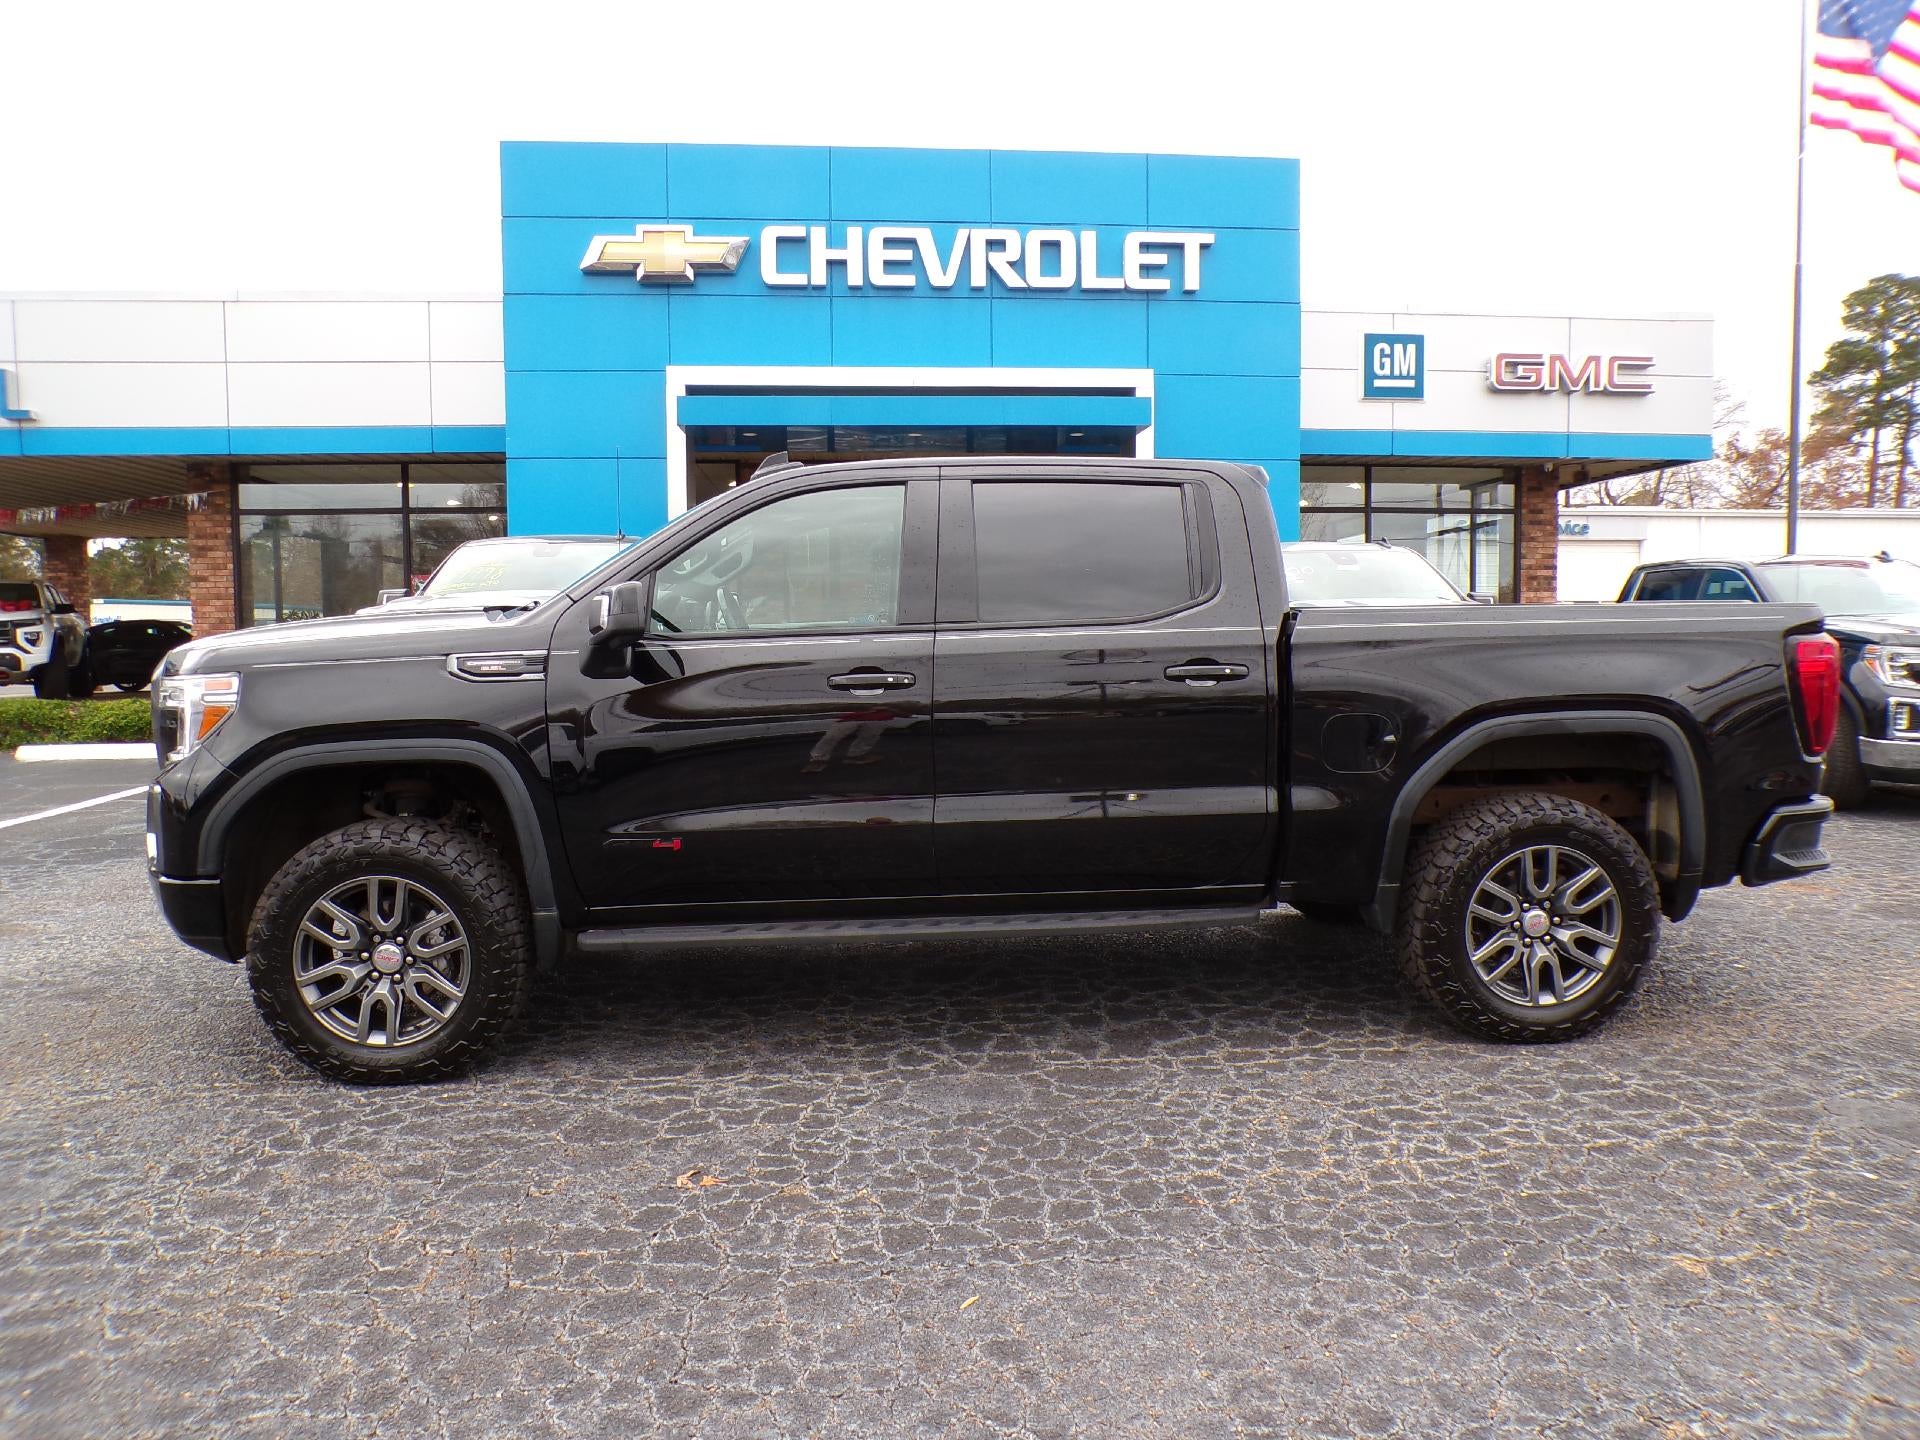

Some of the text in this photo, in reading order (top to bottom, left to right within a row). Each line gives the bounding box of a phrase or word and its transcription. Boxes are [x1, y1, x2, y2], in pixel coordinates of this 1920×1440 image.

[760, 225, 1215, 291] CHEVROLET
[1373, 342, 1416, 377] GM
[1489, 352, 1656, 395] GMC
[1557, 519, 1590, 536] vice
